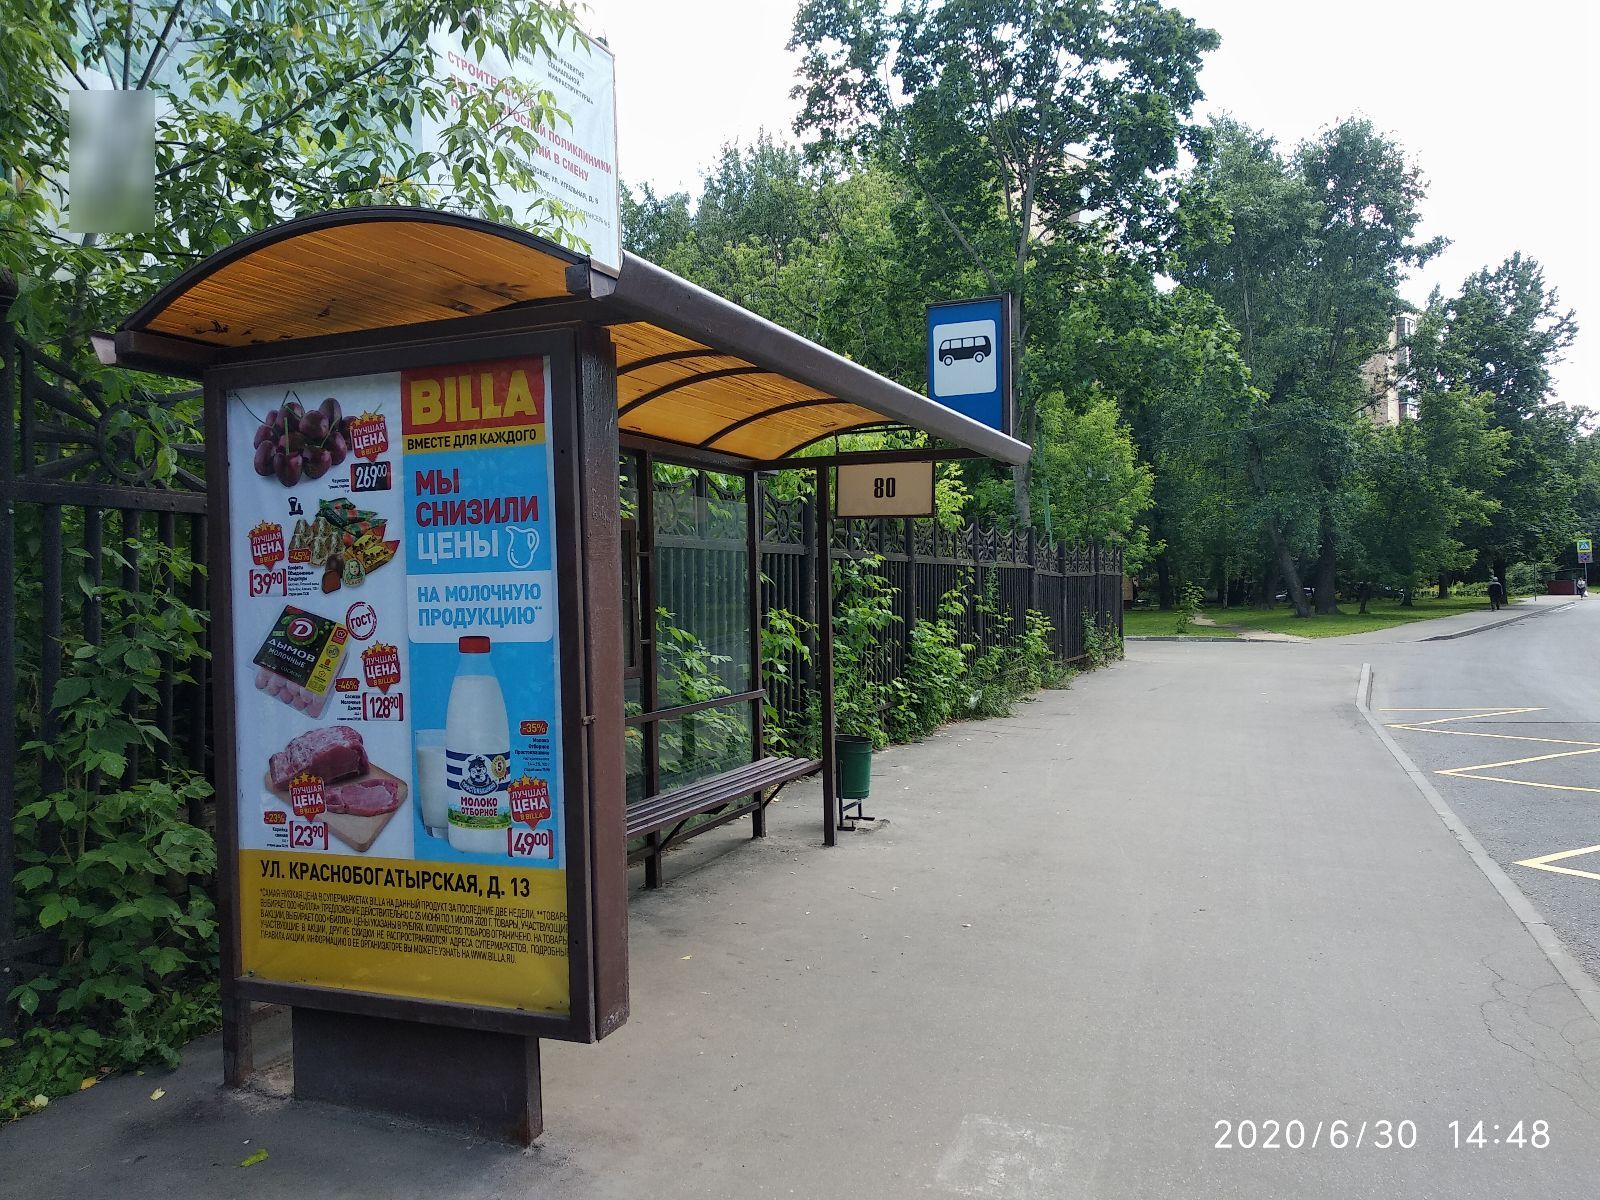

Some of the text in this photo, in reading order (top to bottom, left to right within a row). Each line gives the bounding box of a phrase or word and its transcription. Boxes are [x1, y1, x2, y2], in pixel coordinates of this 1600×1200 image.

[548, 130, 612, 175] ПОЛИКЛИНИКИ
[554, 152, 589, 182] В СМЕНУ
[410, 369, 538, 426] BILLA
[353, 422, 386, 436] ЛУЧШАЯ
[354, 432, 386, 450] ЦЕНА
[407, 428, 536, 451] ВМЕСТЕ ДЛЯ КАЖДОГО
[415, 468, 460, 496] МЫ
[874, 477, 896, 498] 80
[416, 496, 539, 528] СНИЗИЛИ
[252, 532, 282, 546] ЛУЧШАЯ
[418, 529, 499, 565] ЦЕНЫ
[253, 541, 283, 558] ЦЕНА
[417, 583, 542, 602] НА МОЛОЧНУЮ
[350, 612, 372, 630] ГОСТ
[268, 638, 316, 664] ДЫМОВ
[268, 648, 307, 670] МОЛОЧНЫЕ
[366, 654, 398, 666] ЛУЧШАЯ
[366, 662, 399, 680] ЦЕНА
[522, 724, 546, 734] -35%
[292, 784, 322, 795] ЛУЧШАЯ
[512, 788, 548, 800] ЛУЧШАЯ
[293, 793, 324, 808] ЦЕНА
[460, 796, 498, 808] МОЛОКО
[512, 797, 548, 814] ЦЕНА
[461, 806, 498, 817] ОТБОРНОЕ
[260, 860, 530, 900] УЛ. КРАСНОБОГАТЫРСКАЯ, Д. 13
[370, 896, 386, 906] BILLA
[394, 898, 420, 910] ДАННЫЙ
[422, 901, 446, 912] ПРОДУКТ
[448, 903, 456, 912] ЗА
[457, 904, 494, 916] ПОСЛЕДНИЕ
[494, 907, 508, 917] ДВЕ
[328, 925, 350, 936] ДРУГИЕ
[449, 936, 472, 947] АДРЕСА
[464, 926, 490, 937] ТОВАРОВ
[360, 939, 402, 951] ОРГАНИЗАТОРЕ
[403, 943, 412, 952] ВЫ
[413, 944, 437, 955] МОЖЕТЕ
[438, 946, 460, 957] УЗНАТЬ
